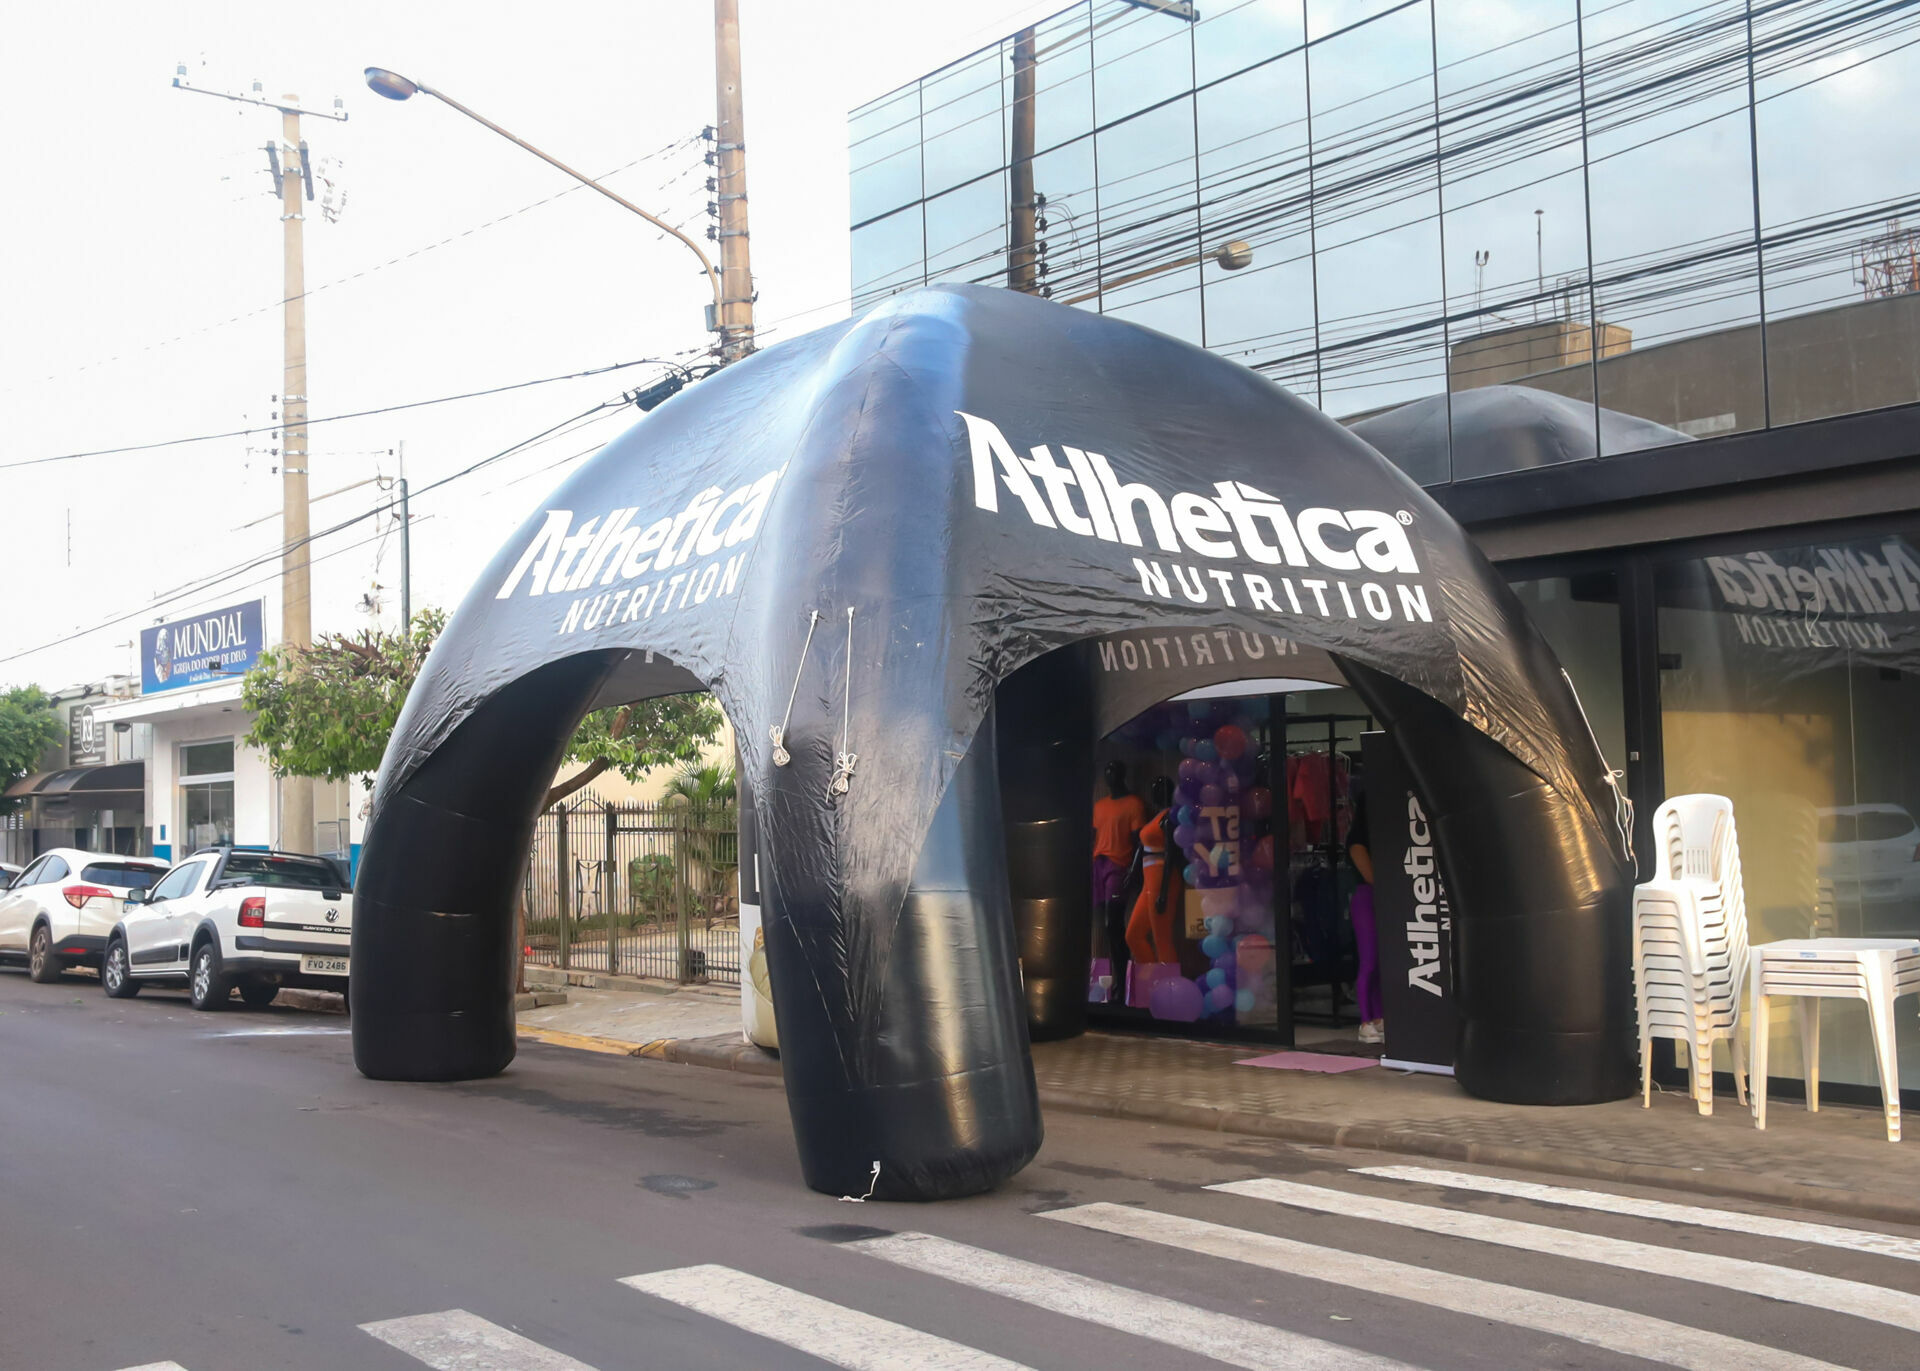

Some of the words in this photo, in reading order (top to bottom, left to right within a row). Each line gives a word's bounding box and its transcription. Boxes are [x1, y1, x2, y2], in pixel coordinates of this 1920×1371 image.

[559, 552, 746, 635] NUTRITION
[1133, 557, 1433, 623] NUTRITION
[173, 611, 247, 660] MUNDIAL
[173, 661, 191, 676] IGREJA
[191, 659, 201, 671] DO
[221, 652, 230, 666] DE
[231, 648, 247, 663] DEUS
